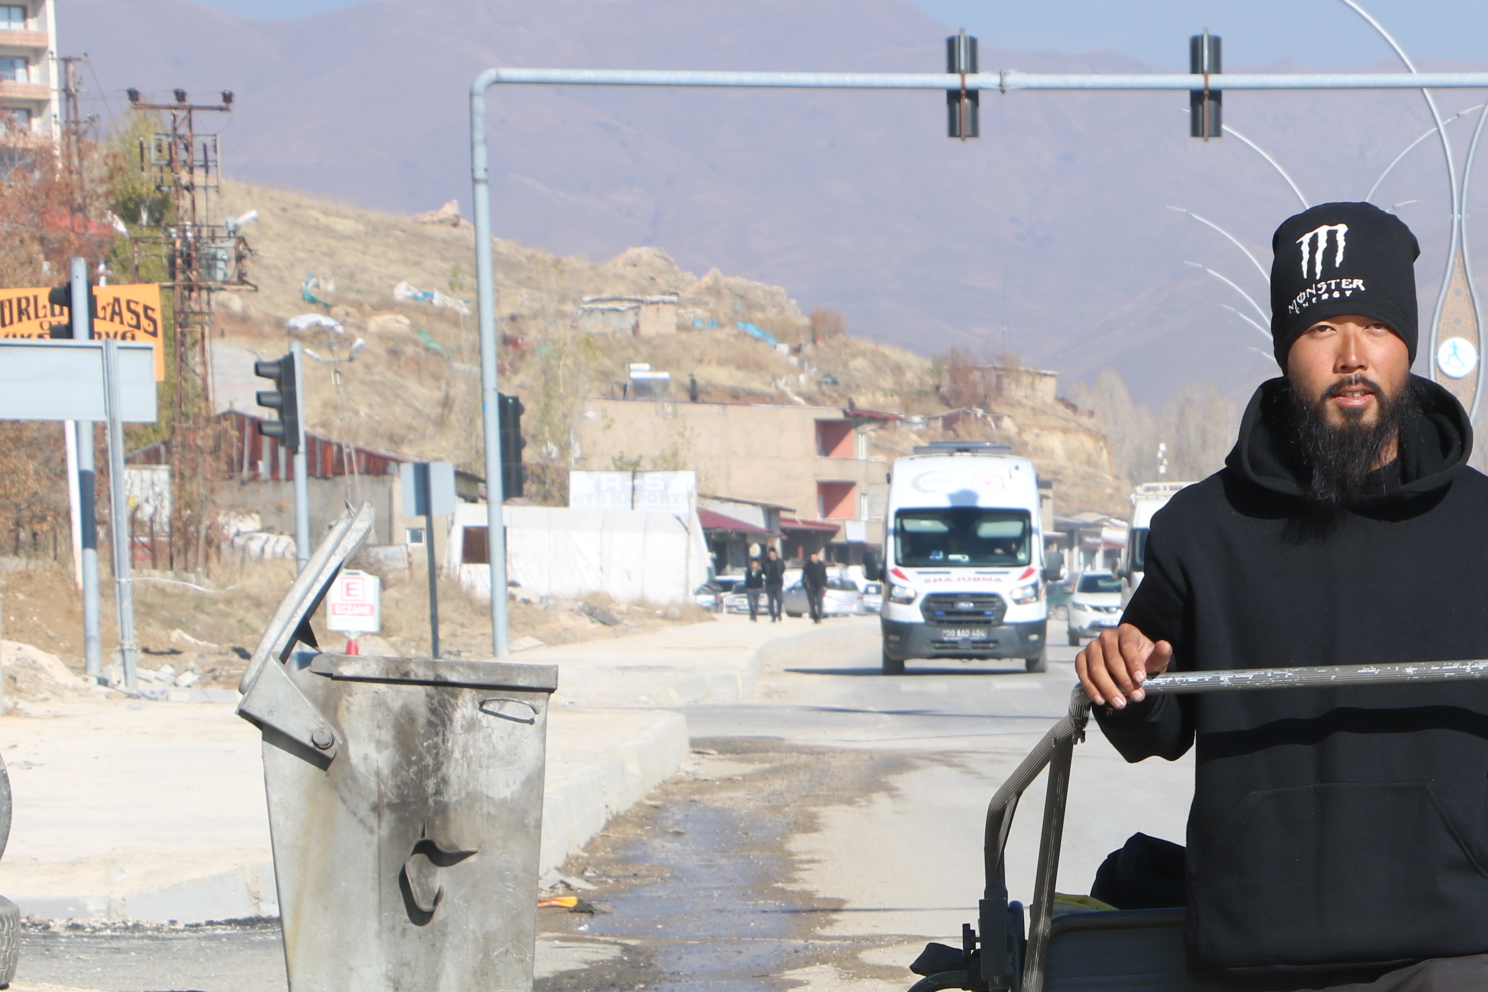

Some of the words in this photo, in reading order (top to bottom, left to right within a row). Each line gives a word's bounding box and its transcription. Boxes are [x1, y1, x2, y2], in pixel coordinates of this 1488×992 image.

[1288, 278, 1366, 314] MONSTER
[92, 294, 159, 338] LASS
[345, 582, 360, 597] E
[334, 604, 371, 615] ECZANE
